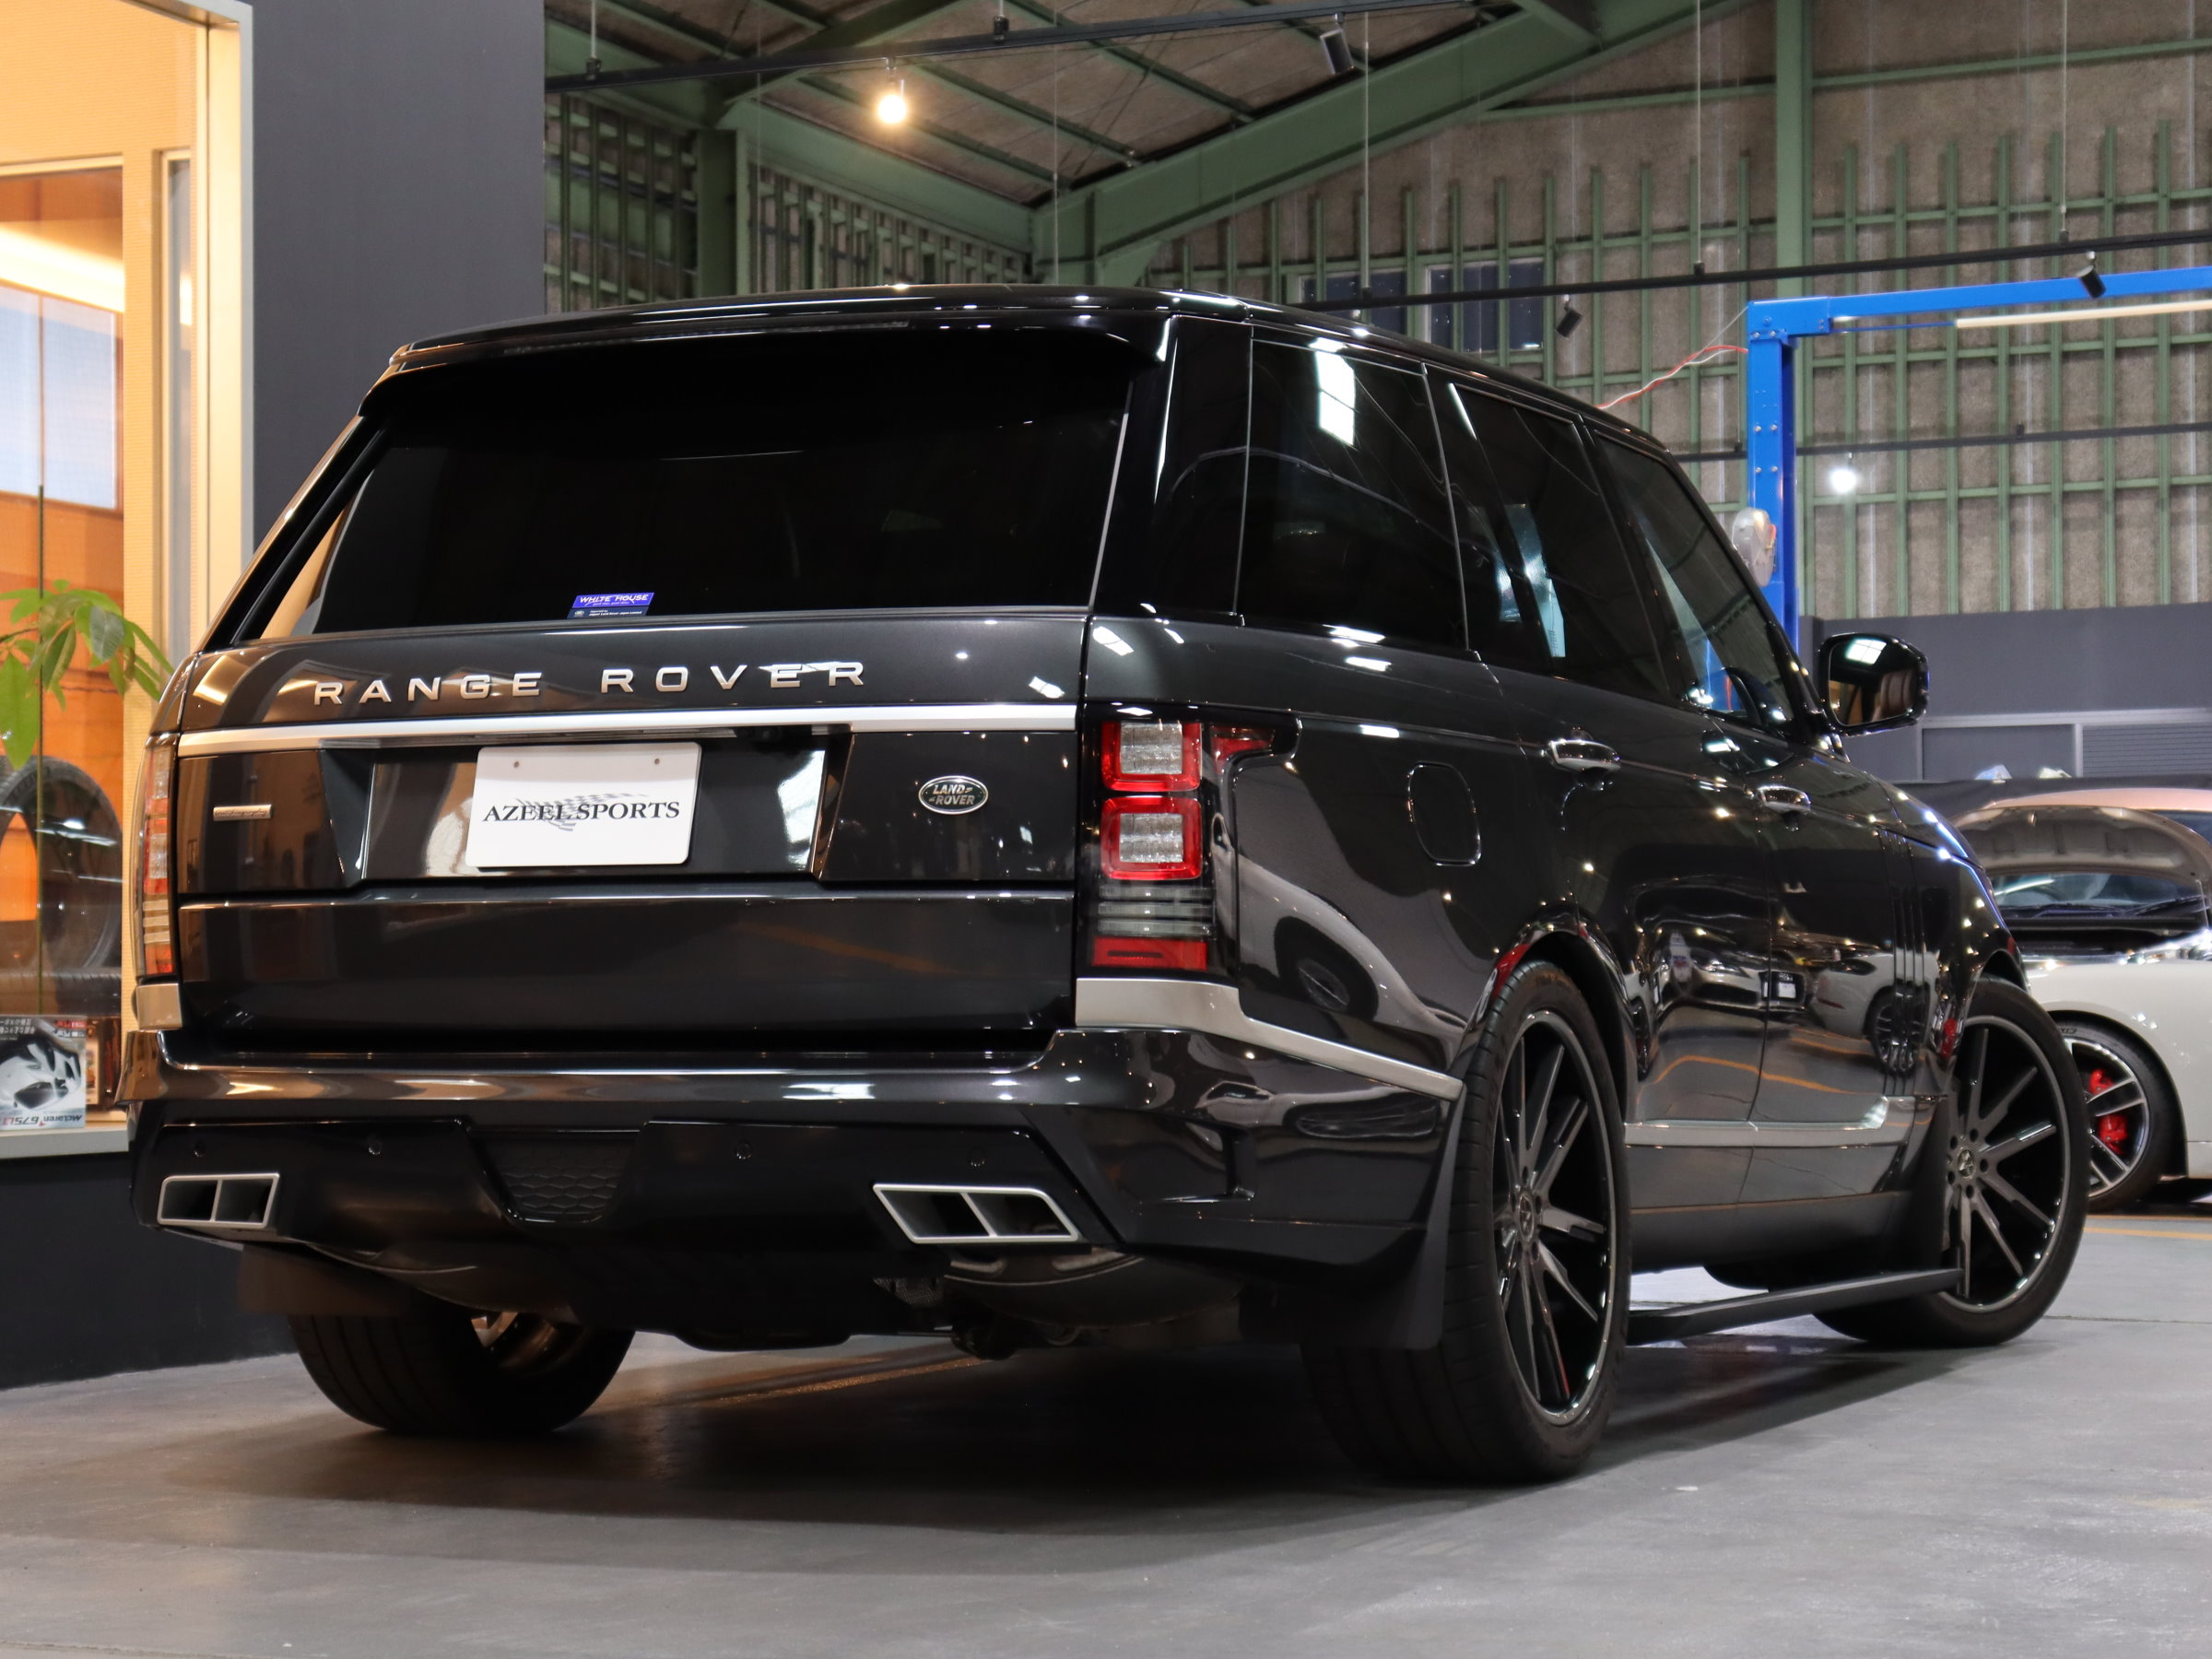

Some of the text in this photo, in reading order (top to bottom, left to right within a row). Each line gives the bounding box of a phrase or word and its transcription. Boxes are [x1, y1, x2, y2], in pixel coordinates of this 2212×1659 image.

[580, 595, 611, 605] WHITE
[615, 594, 649, 604] HOUSE
[313, 660, 865, 706] RANGE ROVER
[933, 783, 966, 794] LAND
[935, 794, 975, 805] ROVER
